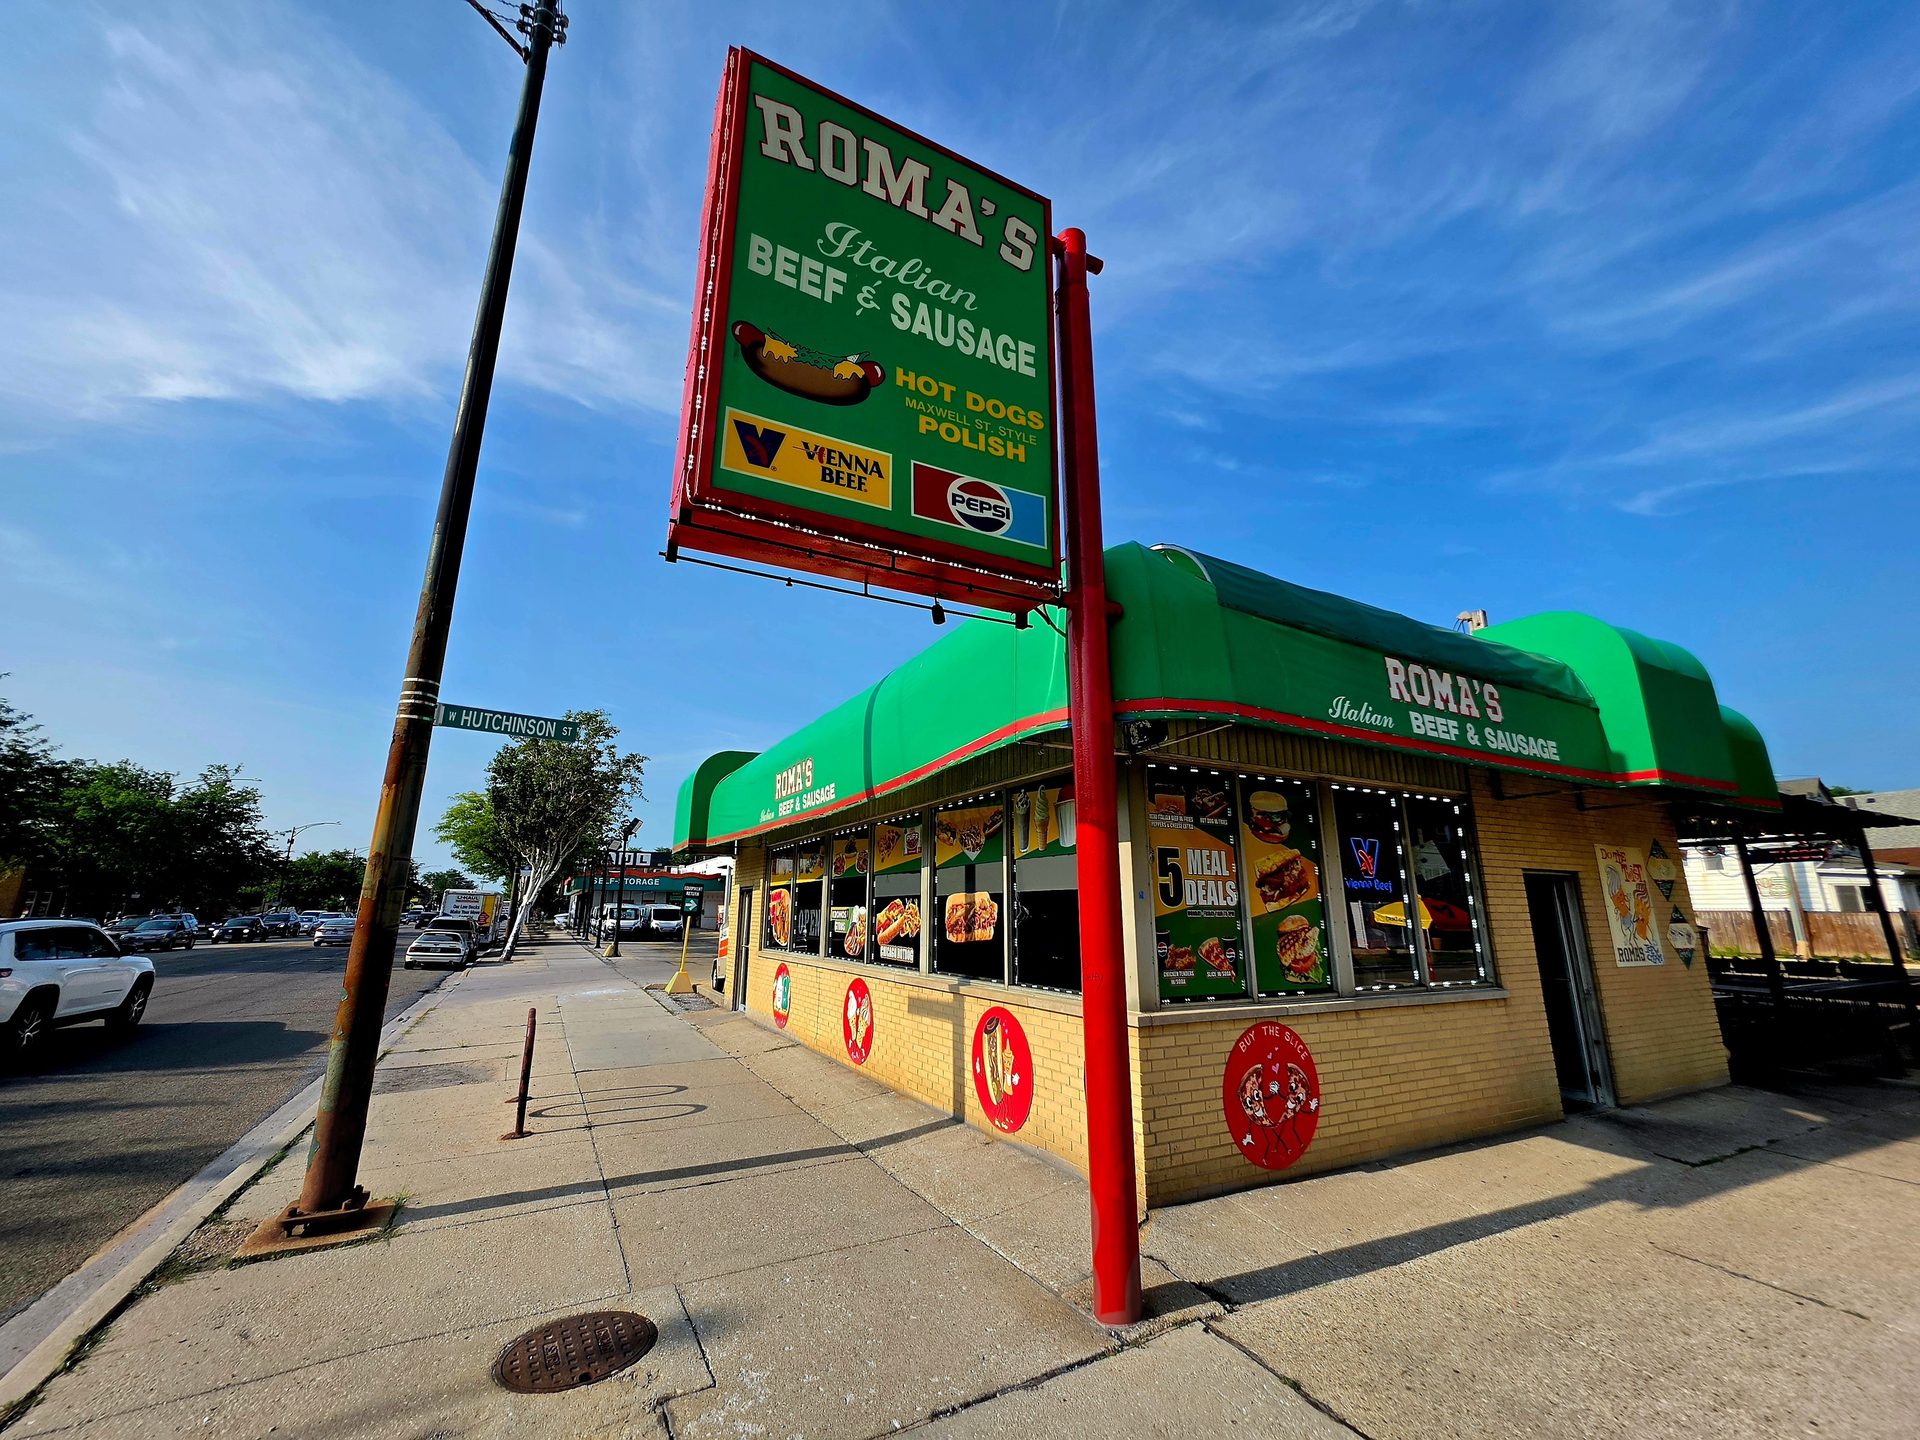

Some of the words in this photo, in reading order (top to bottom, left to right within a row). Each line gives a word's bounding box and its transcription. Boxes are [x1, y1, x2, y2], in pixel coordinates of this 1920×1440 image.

[754, 94, 1038, 272] ROMA'S
[817, 222, 978, 311] Italian
[748, 233, 847, 304] BEEF
[857, 280, 880, 316] &
[890, 293, 1036, 377] SAUSAGE
[896, 367, 956, 403] HOT
[966, 392, 1045, 430] DOGS
[905, 397, 970, 426] MAXWELL
[975, 418, 995, 433] ST.
[998, 425, 1037, 445] STYLE
[919, 415, 1026, 462] POLISH
[821, 465, 867, 492] BEEF
[951, 492, 1011, 520] PEPSI
[1328, 695, 1395, 729] Italian
[1384, 657, 1504, 723] ROMA'S
[449, 711, 457, 721] W
[460, 709, 557, 737] HUTCHINSON
[562, 726, 573, 736] ST
[1409, 711, 1459, 741] BEEF
[1466, 722, 1481, 746] &
[1485, 728, 1560, 761] SAUSAGE
[775, 757, 814, 800] ROMA'S
[779, 799, 794, 816] BEEF
[795, 796, 801, 811] &
[803, 783, 836, 809] SAUSAGE
[1157, 846, 1184, 908] 5
[1186, 848, 1229, 876] MEAL
[1184, 879, 1238, 907] DEALS
[1344, 877, 1372, 889] Vienna
[1239, 1030, 1255, 1052] BUY
[1262, 1025, 1280, 1037] THE
[1284, 1031, 1309, 1061] SLICE
